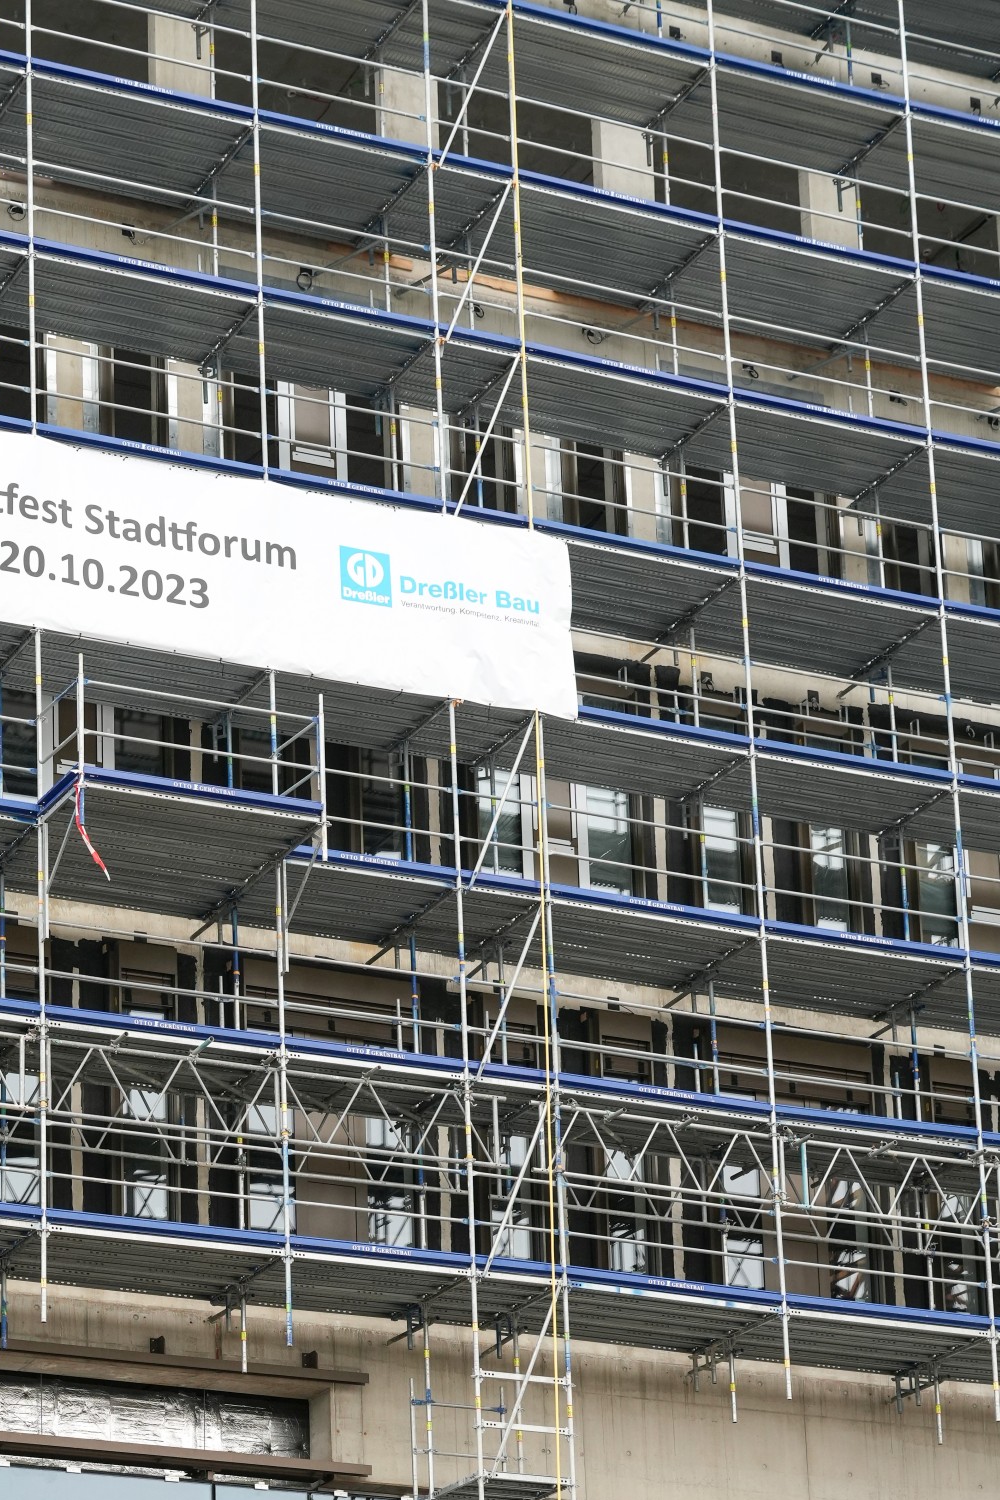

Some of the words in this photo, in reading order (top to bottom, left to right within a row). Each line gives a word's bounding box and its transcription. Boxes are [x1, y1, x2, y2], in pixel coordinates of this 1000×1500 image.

[317, 123, 333, 131] OTTO
[119, 257, 136, 265] OTTO
[322, 299, 338, 307] OTTO
[84, 505, 297, 569] Stadtforum
[0, 540, 210, 609] 20.10.2023
[343, 586, 391, 605] Dreßler
[400, 575, 487, 604] Dreßler
[495, 590, 540, 615] Bau
